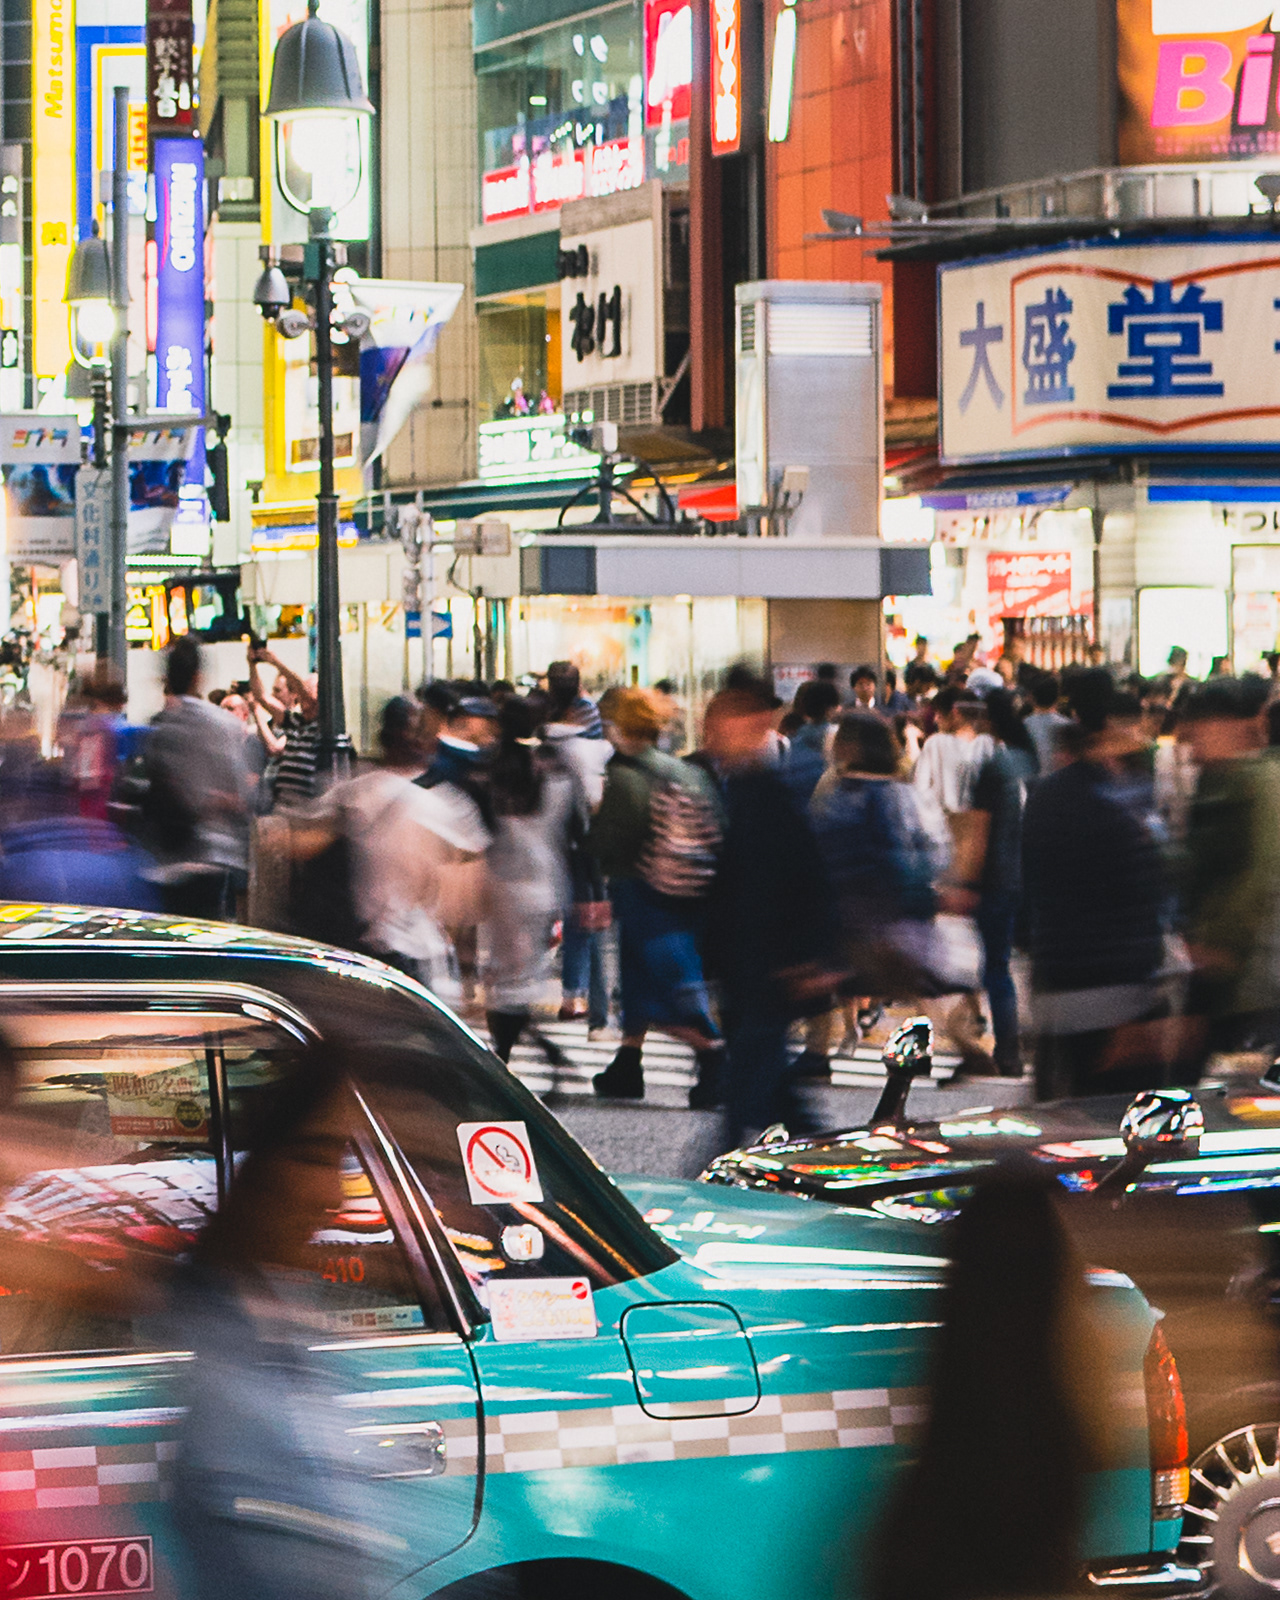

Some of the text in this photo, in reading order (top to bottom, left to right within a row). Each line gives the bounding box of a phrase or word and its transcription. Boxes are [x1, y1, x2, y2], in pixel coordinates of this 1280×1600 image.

[1150, 33, 1280, 129] Bi
[958, 279, 1280, 415] 大盛堂
[38, 1539, 149, 1593] 1070
